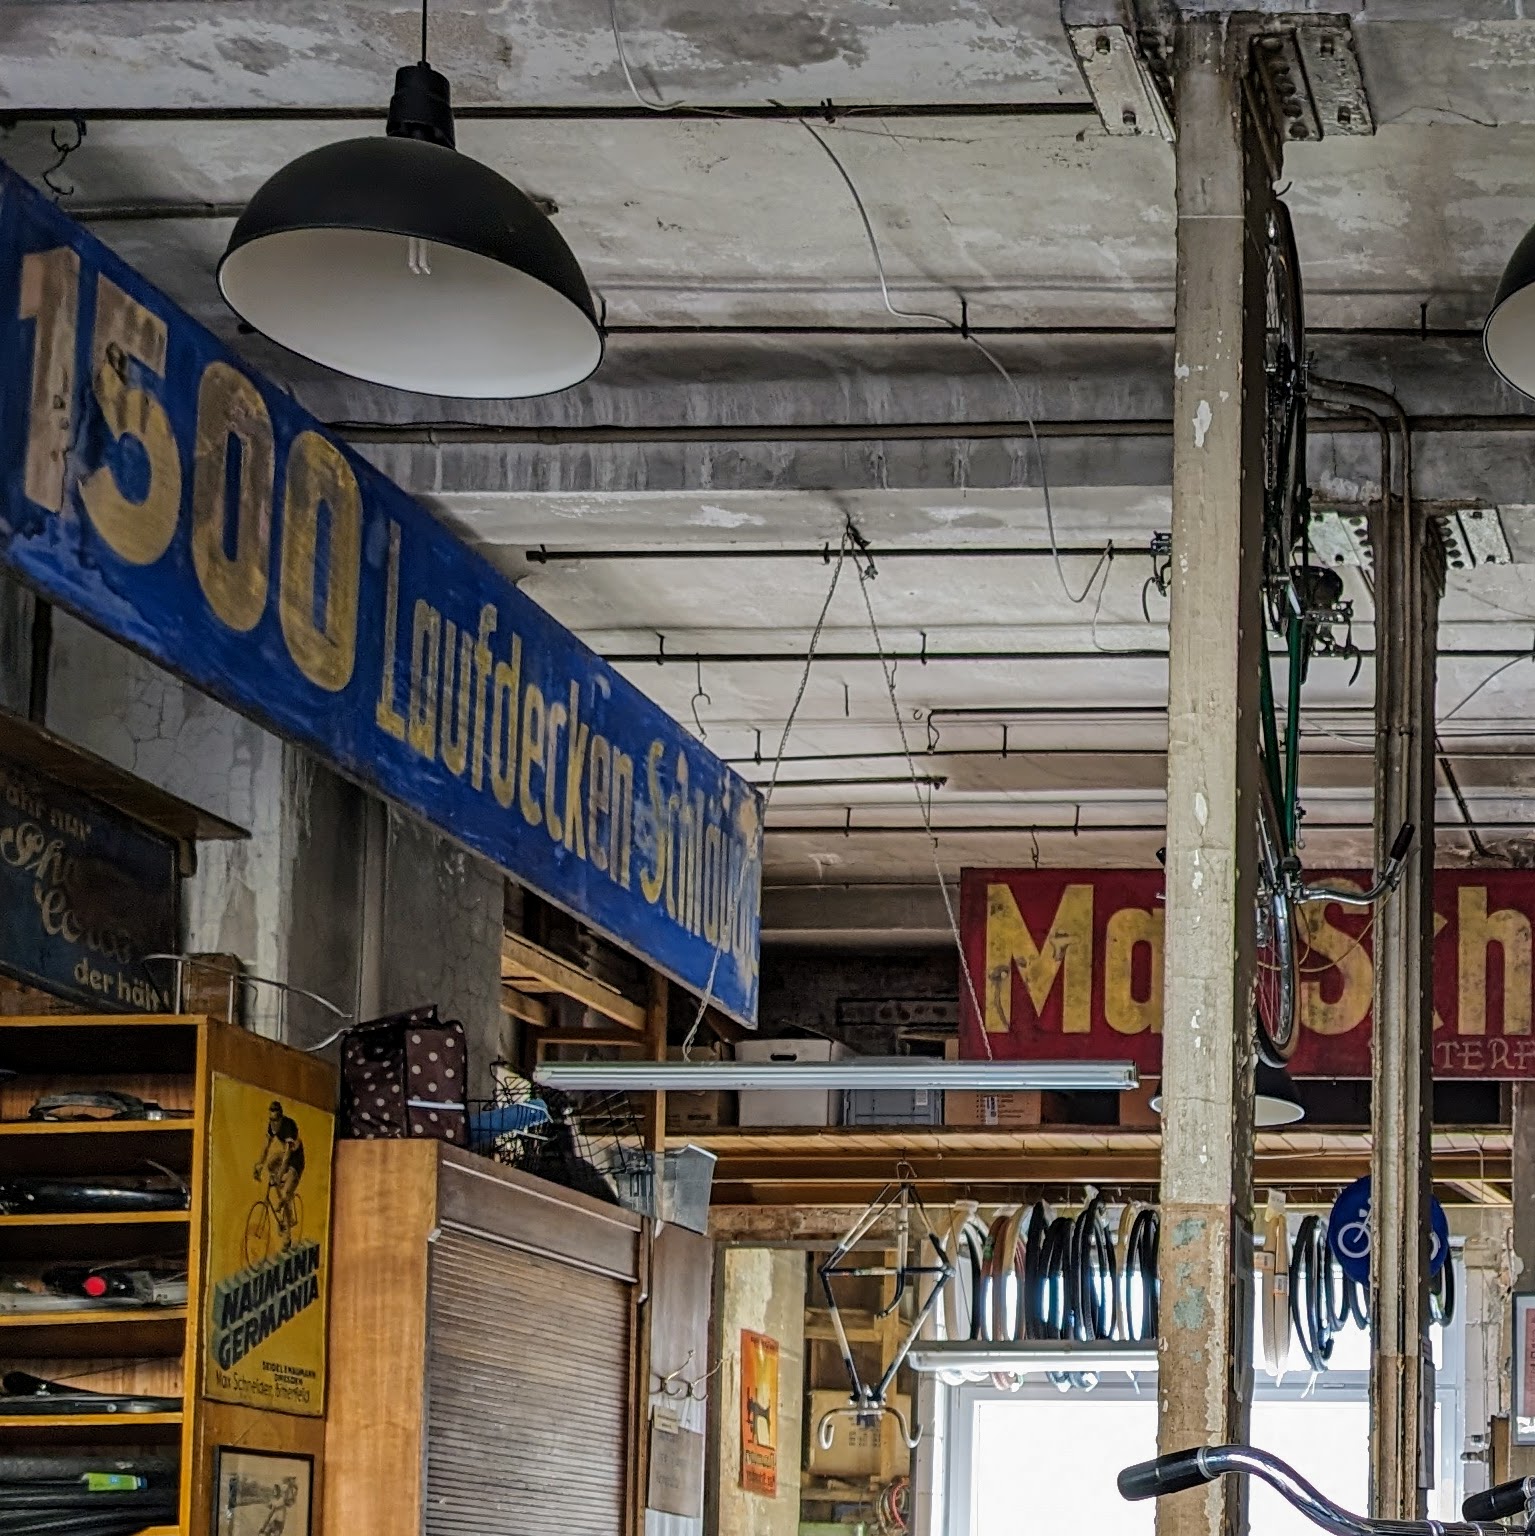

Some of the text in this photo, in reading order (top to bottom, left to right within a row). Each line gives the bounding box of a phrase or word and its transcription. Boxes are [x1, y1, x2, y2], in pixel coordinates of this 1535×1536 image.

[19, 245, 363, 692] 1500
[376, 519, 633, 890] Laufdecken
[74, 957, 112, 996] der
[986, 882, 1165, 1035] Ma
[217, 1273, 319, 1372] GERMANIA
[220, 1243, 321, 1331] NAUMANN
